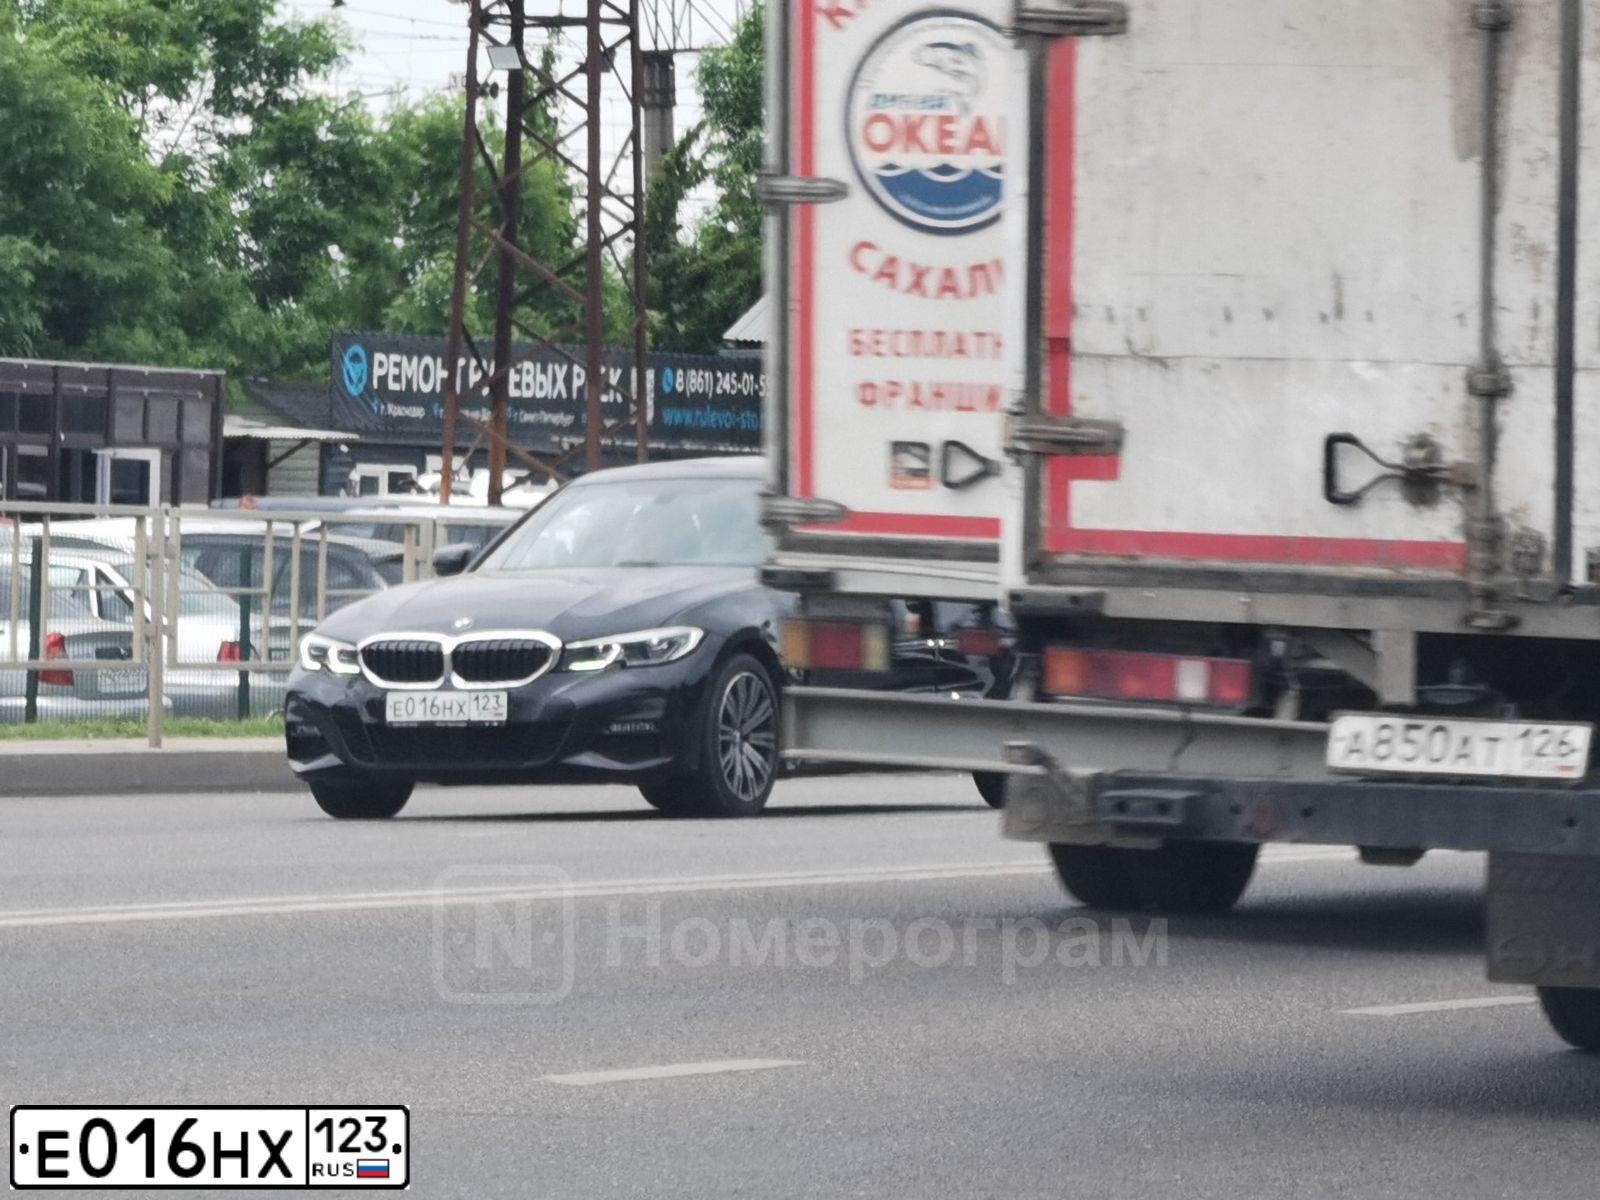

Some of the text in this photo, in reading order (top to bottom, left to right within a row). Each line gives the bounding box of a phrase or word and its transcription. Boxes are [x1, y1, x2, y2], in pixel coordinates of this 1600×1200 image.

[862, 113, 1003, 156] ОКЕА
[468, 357, 568, 399] РУЕВЫХ
[675, 368, 768, 400] 8 (861) 245-01-5
[392, 694, 501, 718] Е016НХ 123
[1345, 723, 1577, 766] А850АТ 126
